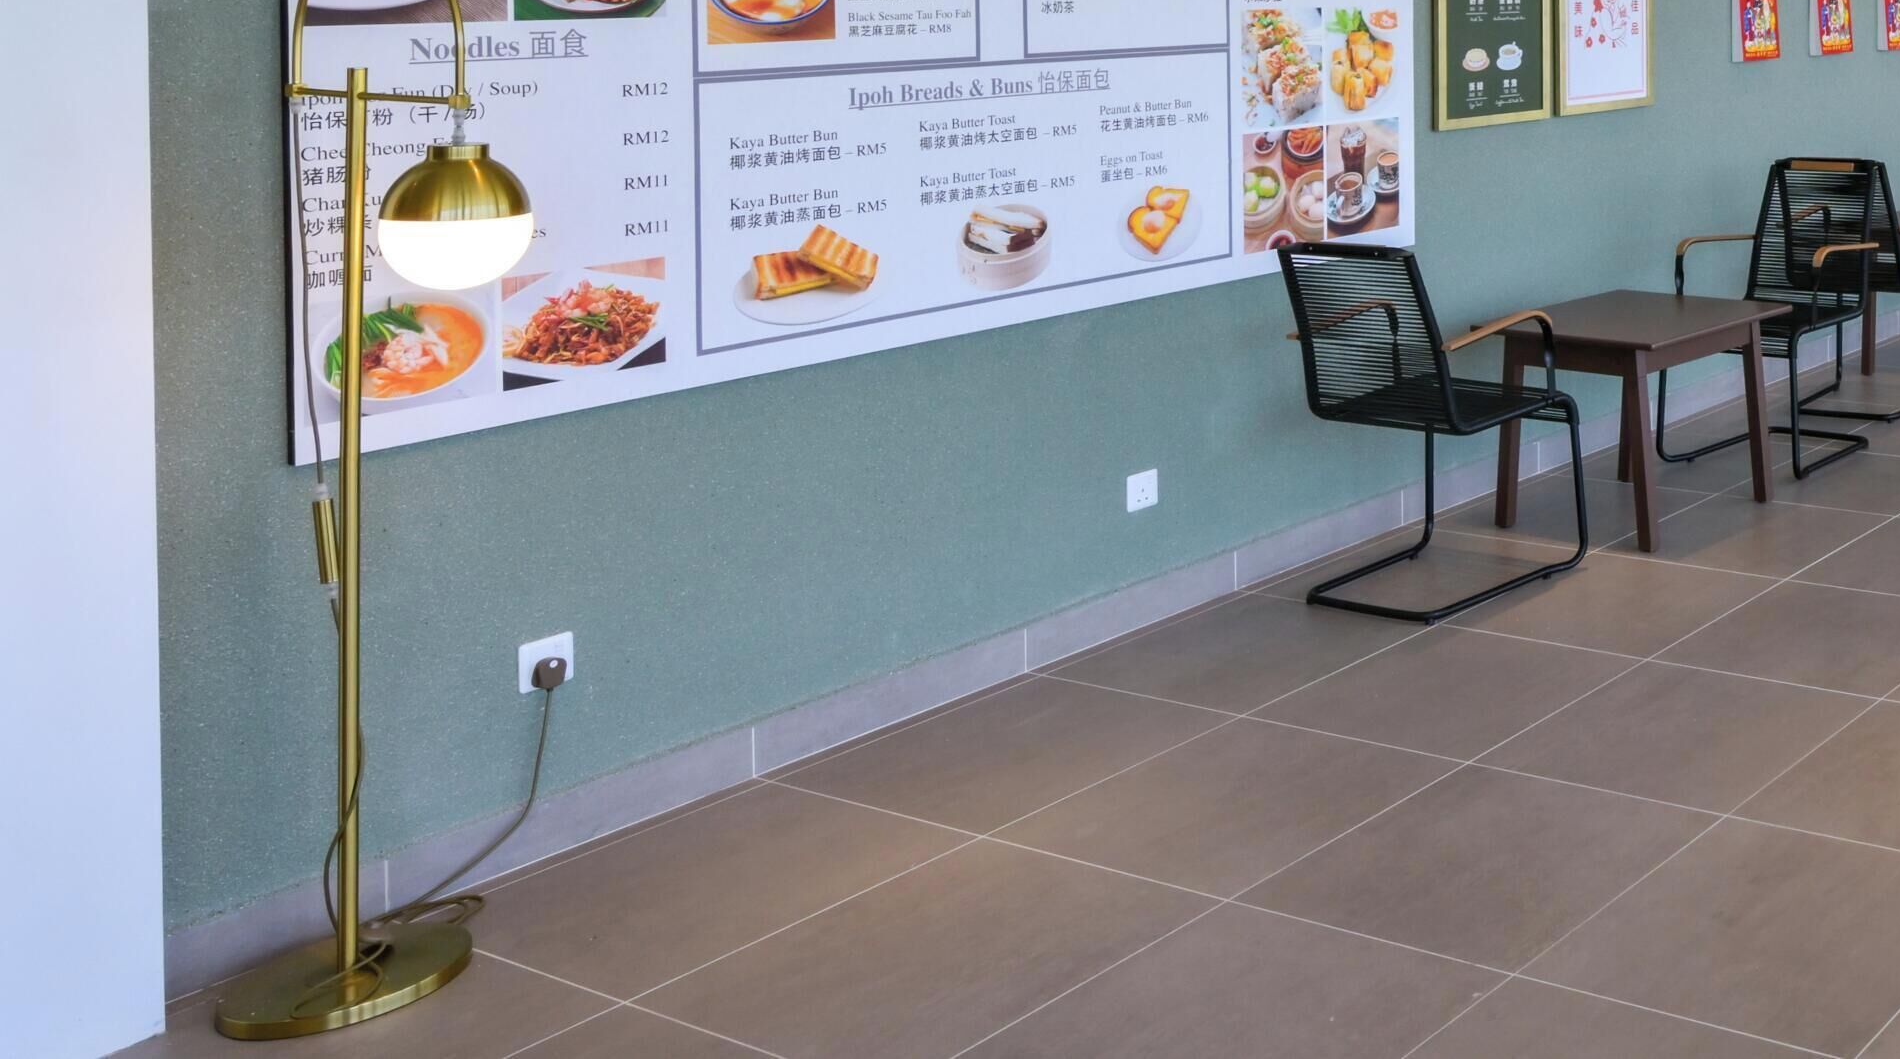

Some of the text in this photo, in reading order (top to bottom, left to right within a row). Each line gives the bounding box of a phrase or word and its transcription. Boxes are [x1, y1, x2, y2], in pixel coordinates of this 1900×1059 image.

[529, 28, 587, 57] 面食
[489, 81, 538, 97] Soup)
[622, 81, 668, 97] RM12
[847, 85, 894, 107] Ipoh
[899, 80, 963, 103] Breads
[990, 77, 1033, 97] Buns
[1037, 67, 1110, 93] 怡保面包
[623, 129, 669, 146] RM12
[728, 129, 838, 151] Kaya Butter Bun
[729, 145, 841, 170] 椰浆黄油烤面包
[856, 142, 887, 157] RM5
[1099, 150, 1163, 169] Eggs on Toast
[623, 174, 667, 191] RM11
[624, 219, 668, 237] RM11
